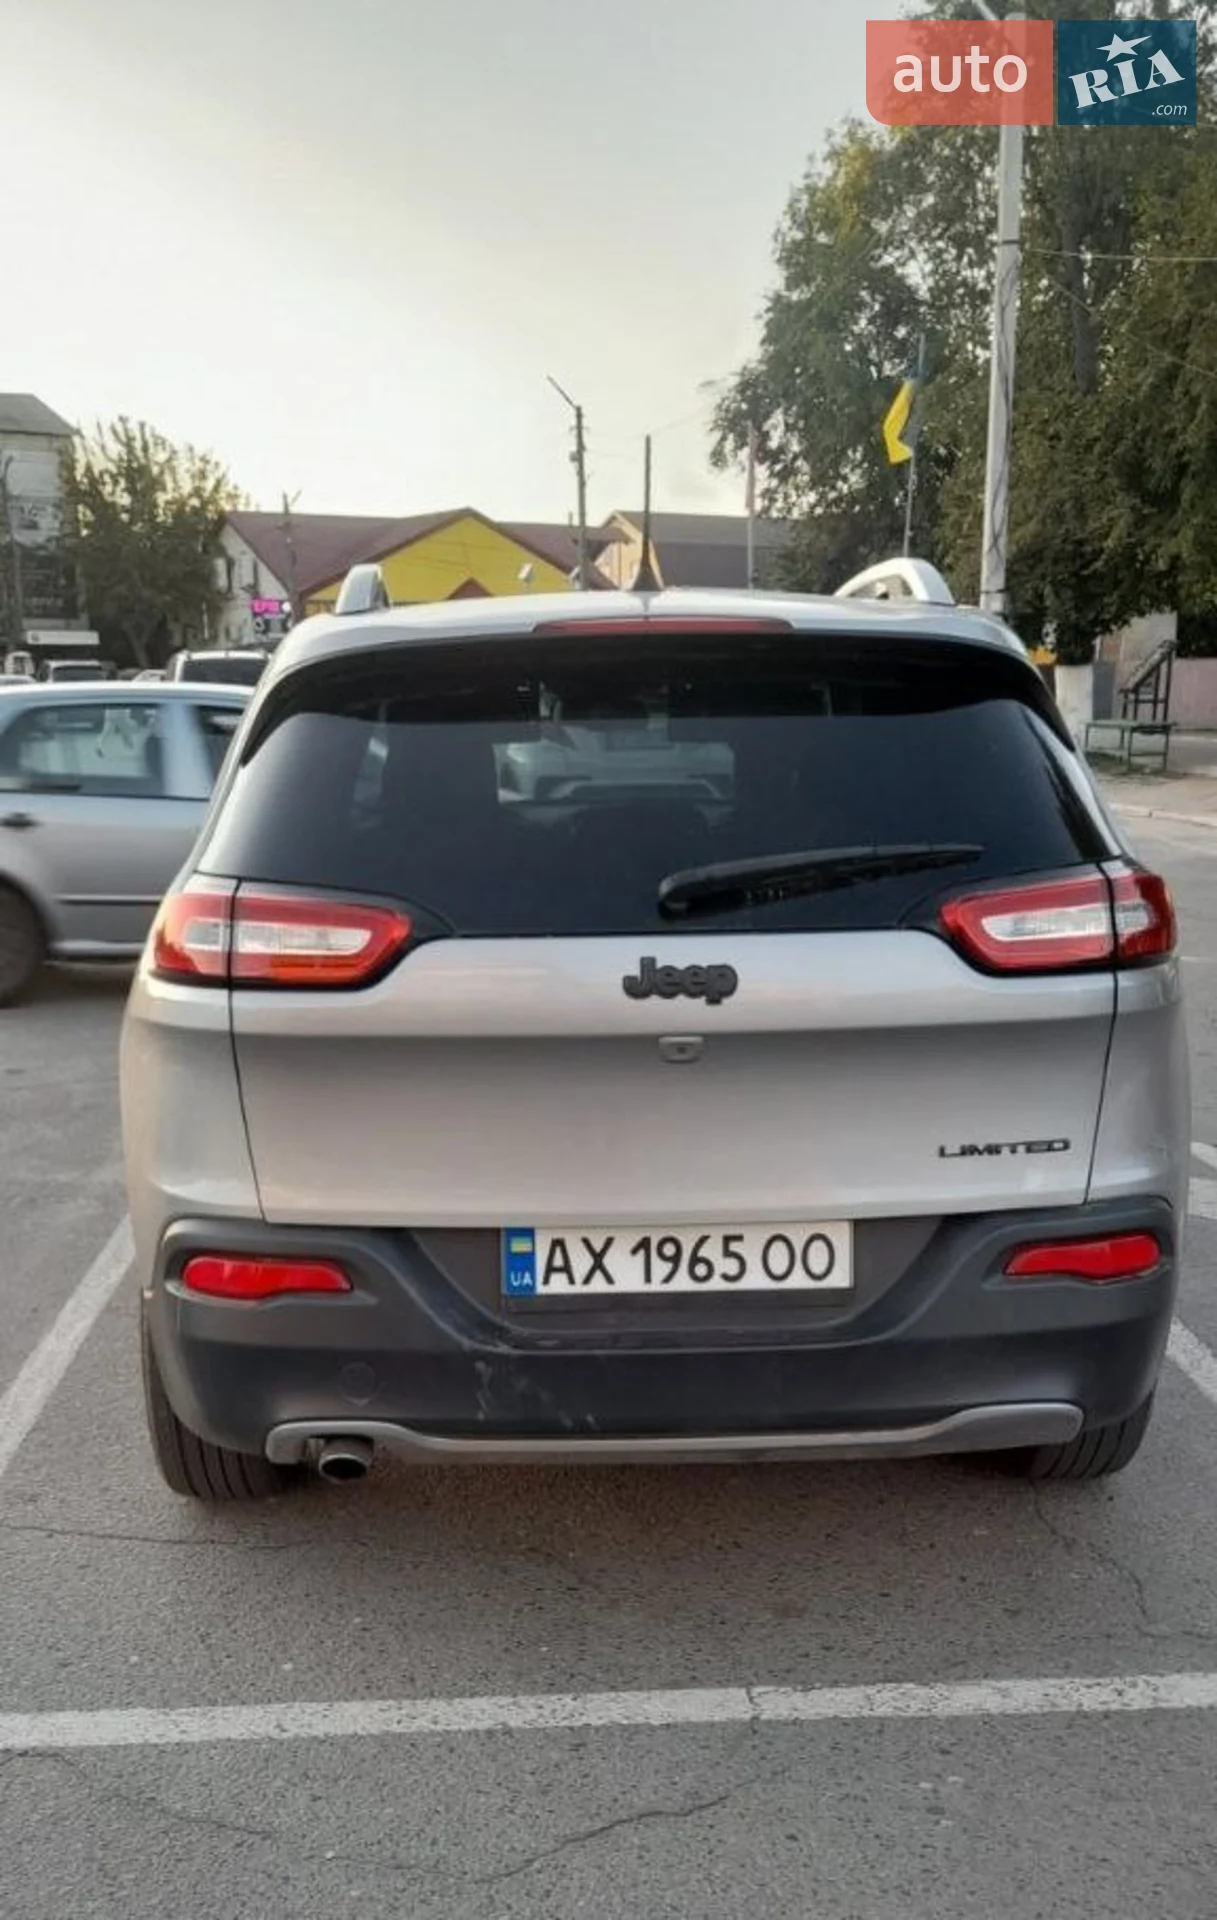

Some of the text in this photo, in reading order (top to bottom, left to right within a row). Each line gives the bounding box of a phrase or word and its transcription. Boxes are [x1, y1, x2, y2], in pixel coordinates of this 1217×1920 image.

[623, 957, 738, 1005] Jeep
[938, 1139, 1070, 1158] LIMITED
[542, 1237, 615, 1286] AX
[630, 1234, 747, 1284] 1965
[510, 1273, 532, 1287] UA
